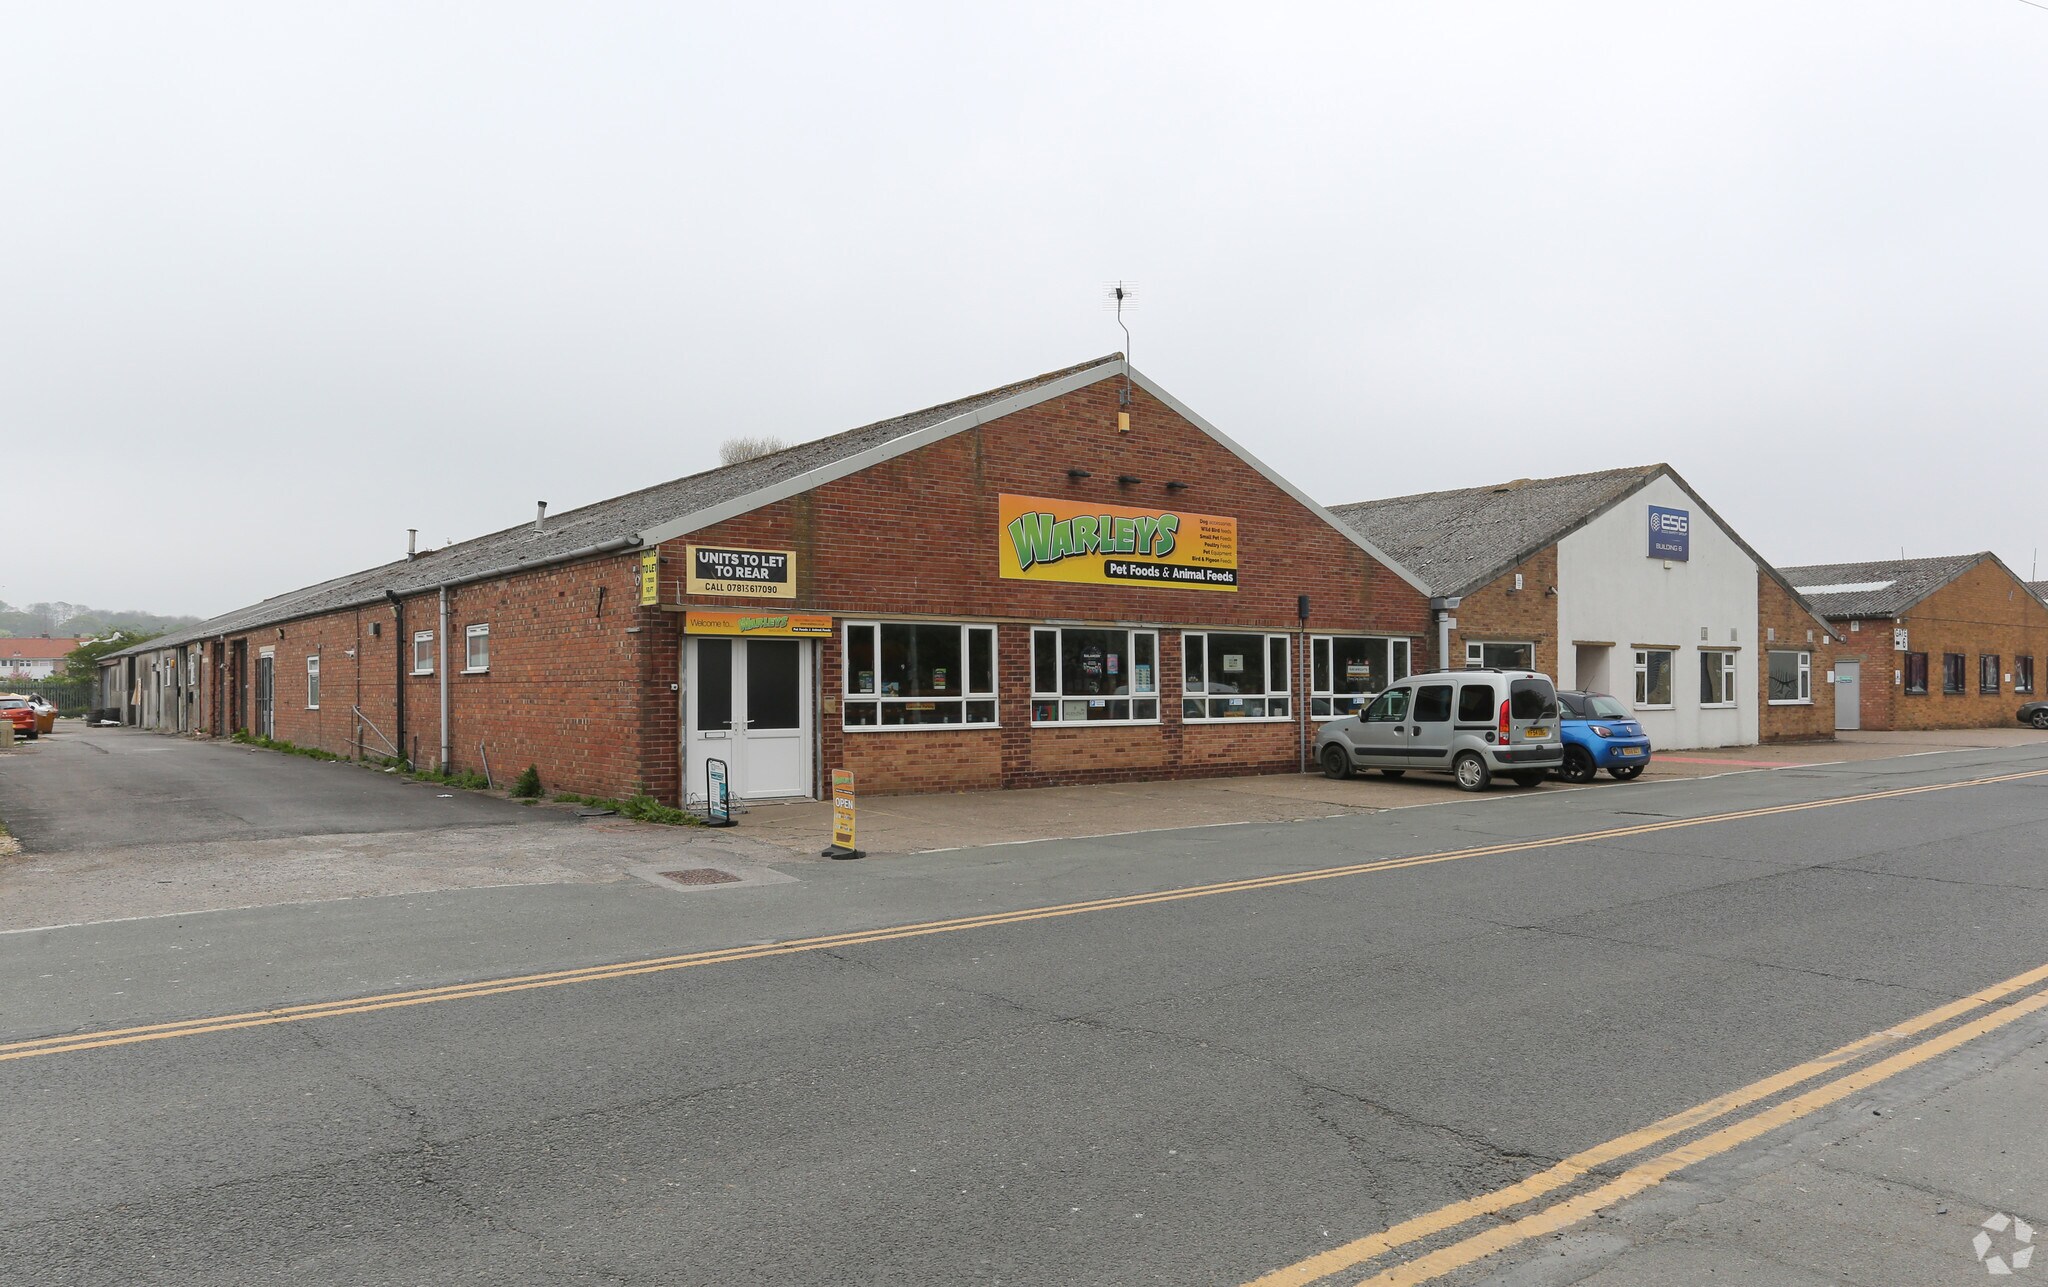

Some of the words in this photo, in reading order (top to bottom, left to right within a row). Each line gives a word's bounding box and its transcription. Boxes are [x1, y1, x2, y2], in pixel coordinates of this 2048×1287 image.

[1662, 514, 1687, 532] ESG
[1007, 511, 1179, 571] WARLEYS
[1656, 542, 1678, 552] BUILDING
[700, 552, 740, 565] UNITS
[742, 554, 759, 566] TO
[762, 556, 784, 568] LET
[715, 566, 732, 577] TO
[736, 566, 769, 579] REAR
[1110, 563, 1128, 575] Pet
[1130, 564, 1160, 577] Foods
[1162, 567, 1170, 578] &
[1172, 568, 1205, 580] Animal
[1207, 570, 1234, 582] Feeds
[705, 582, 724, 592] CALL
[690, 618, 722, 628] Welcome
[738, 616, 789, 632] WARLEYS
[835, 797, 854, 810] OPEN
